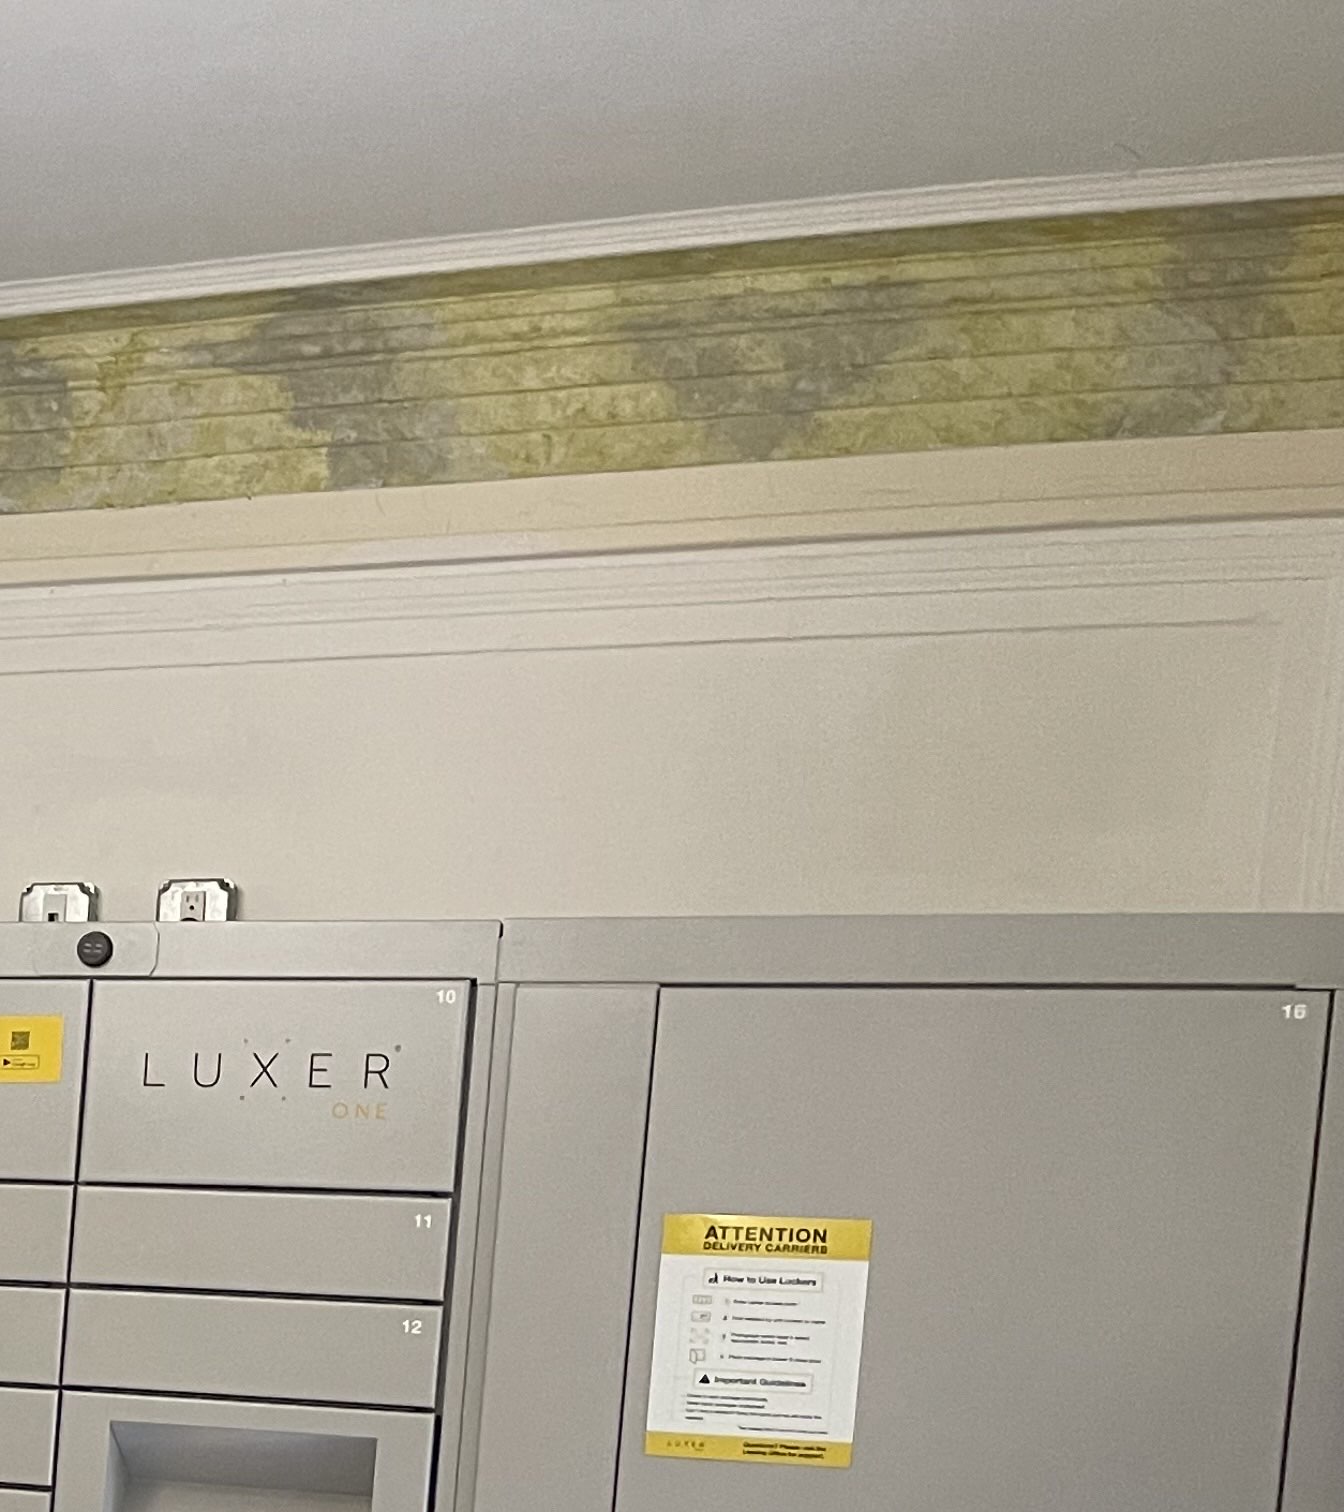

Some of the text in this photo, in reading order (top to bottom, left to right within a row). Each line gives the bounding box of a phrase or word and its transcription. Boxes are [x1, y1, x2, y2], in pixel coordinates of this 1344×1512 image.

[436, 989, 457, 1004] 10
[1281, 1003, 1308, 1020] 16
[142, 1051, 390, 1089] LUXER
[331, 1102, 388, 1121] ONE
[414, 1213, 432, 1229] 11
[704, 1225, 828, 1244] ATTENTION
[703, 1241, 828, 1254] DELIVERY CARRIERS
[758, 1276, 776, 1284] Use
[779, 1276, 816, 1286] Lockers
[402, 1319, 423, 1335] 12
[714, 1376, 806, 1387] Important Guidelines
